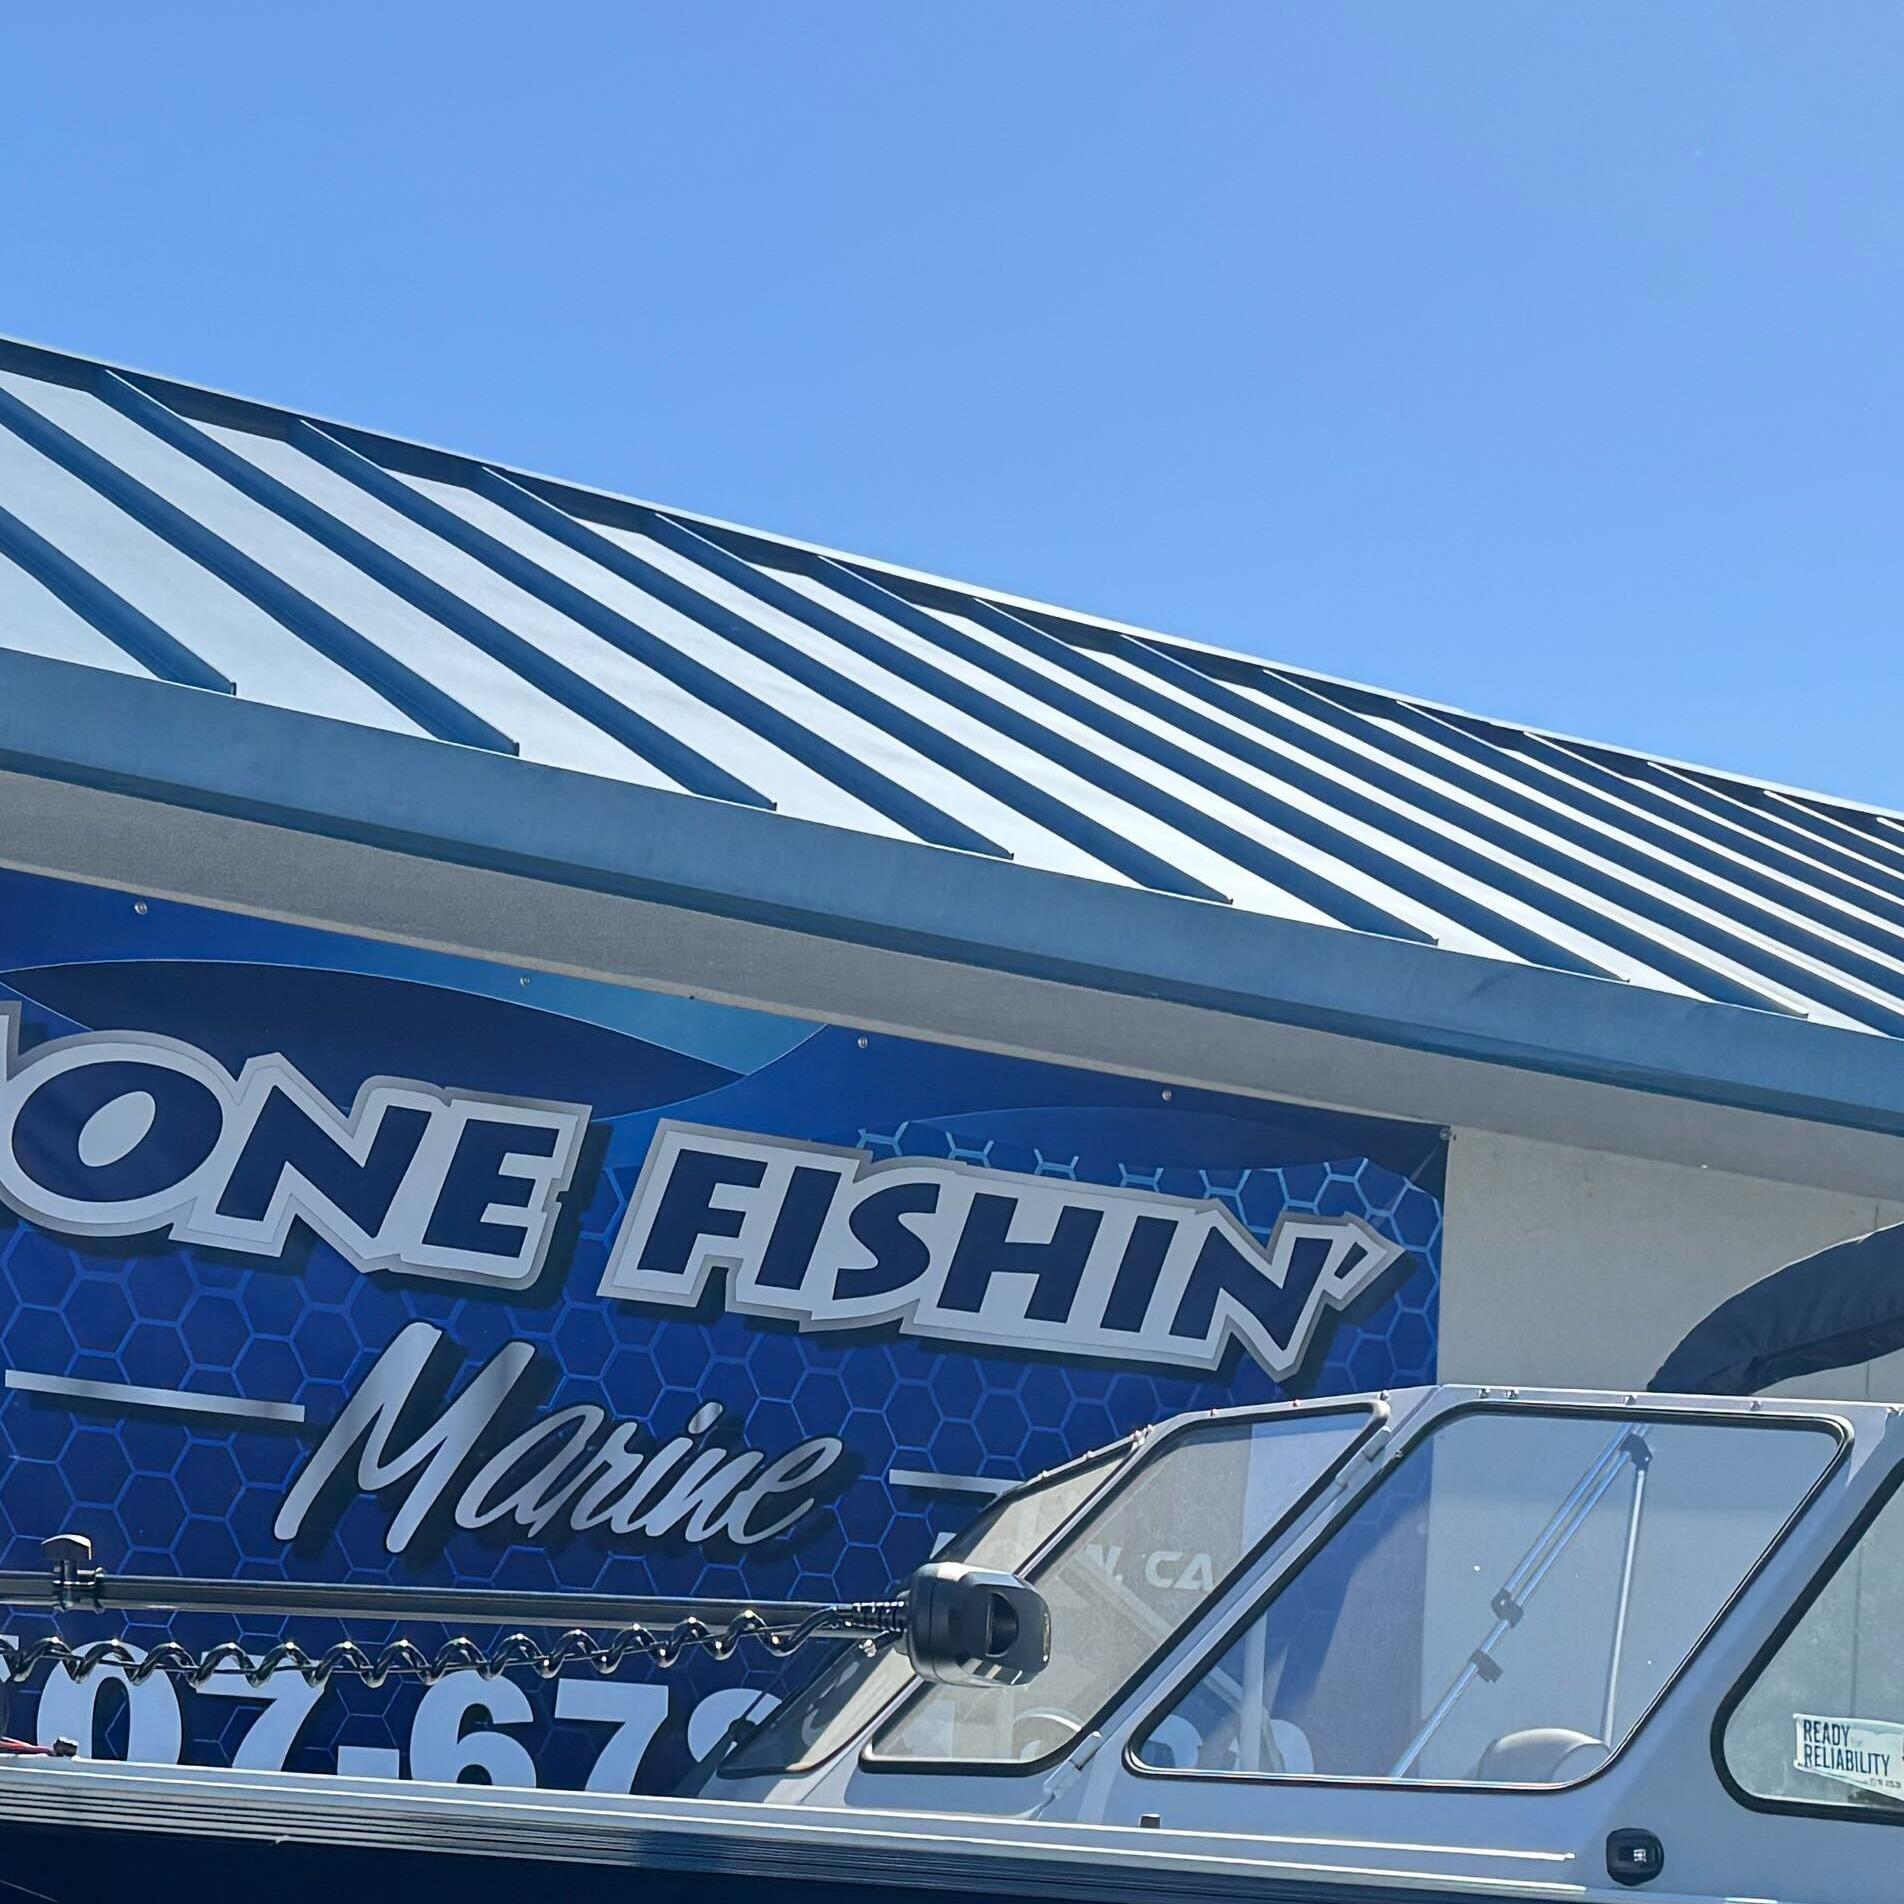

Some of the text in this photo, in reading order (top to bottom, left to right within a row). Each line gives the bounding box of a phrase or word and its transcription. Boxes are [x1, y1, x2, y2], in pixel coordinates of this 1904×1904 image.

[616, 1133, 1383, 1366] FISHIN'
[273, 1321, 843, 1554] Marine
[1802, 1718, 1850, 1747] READY
[1803, 1744, 1891, 1777] RELIABILITY
